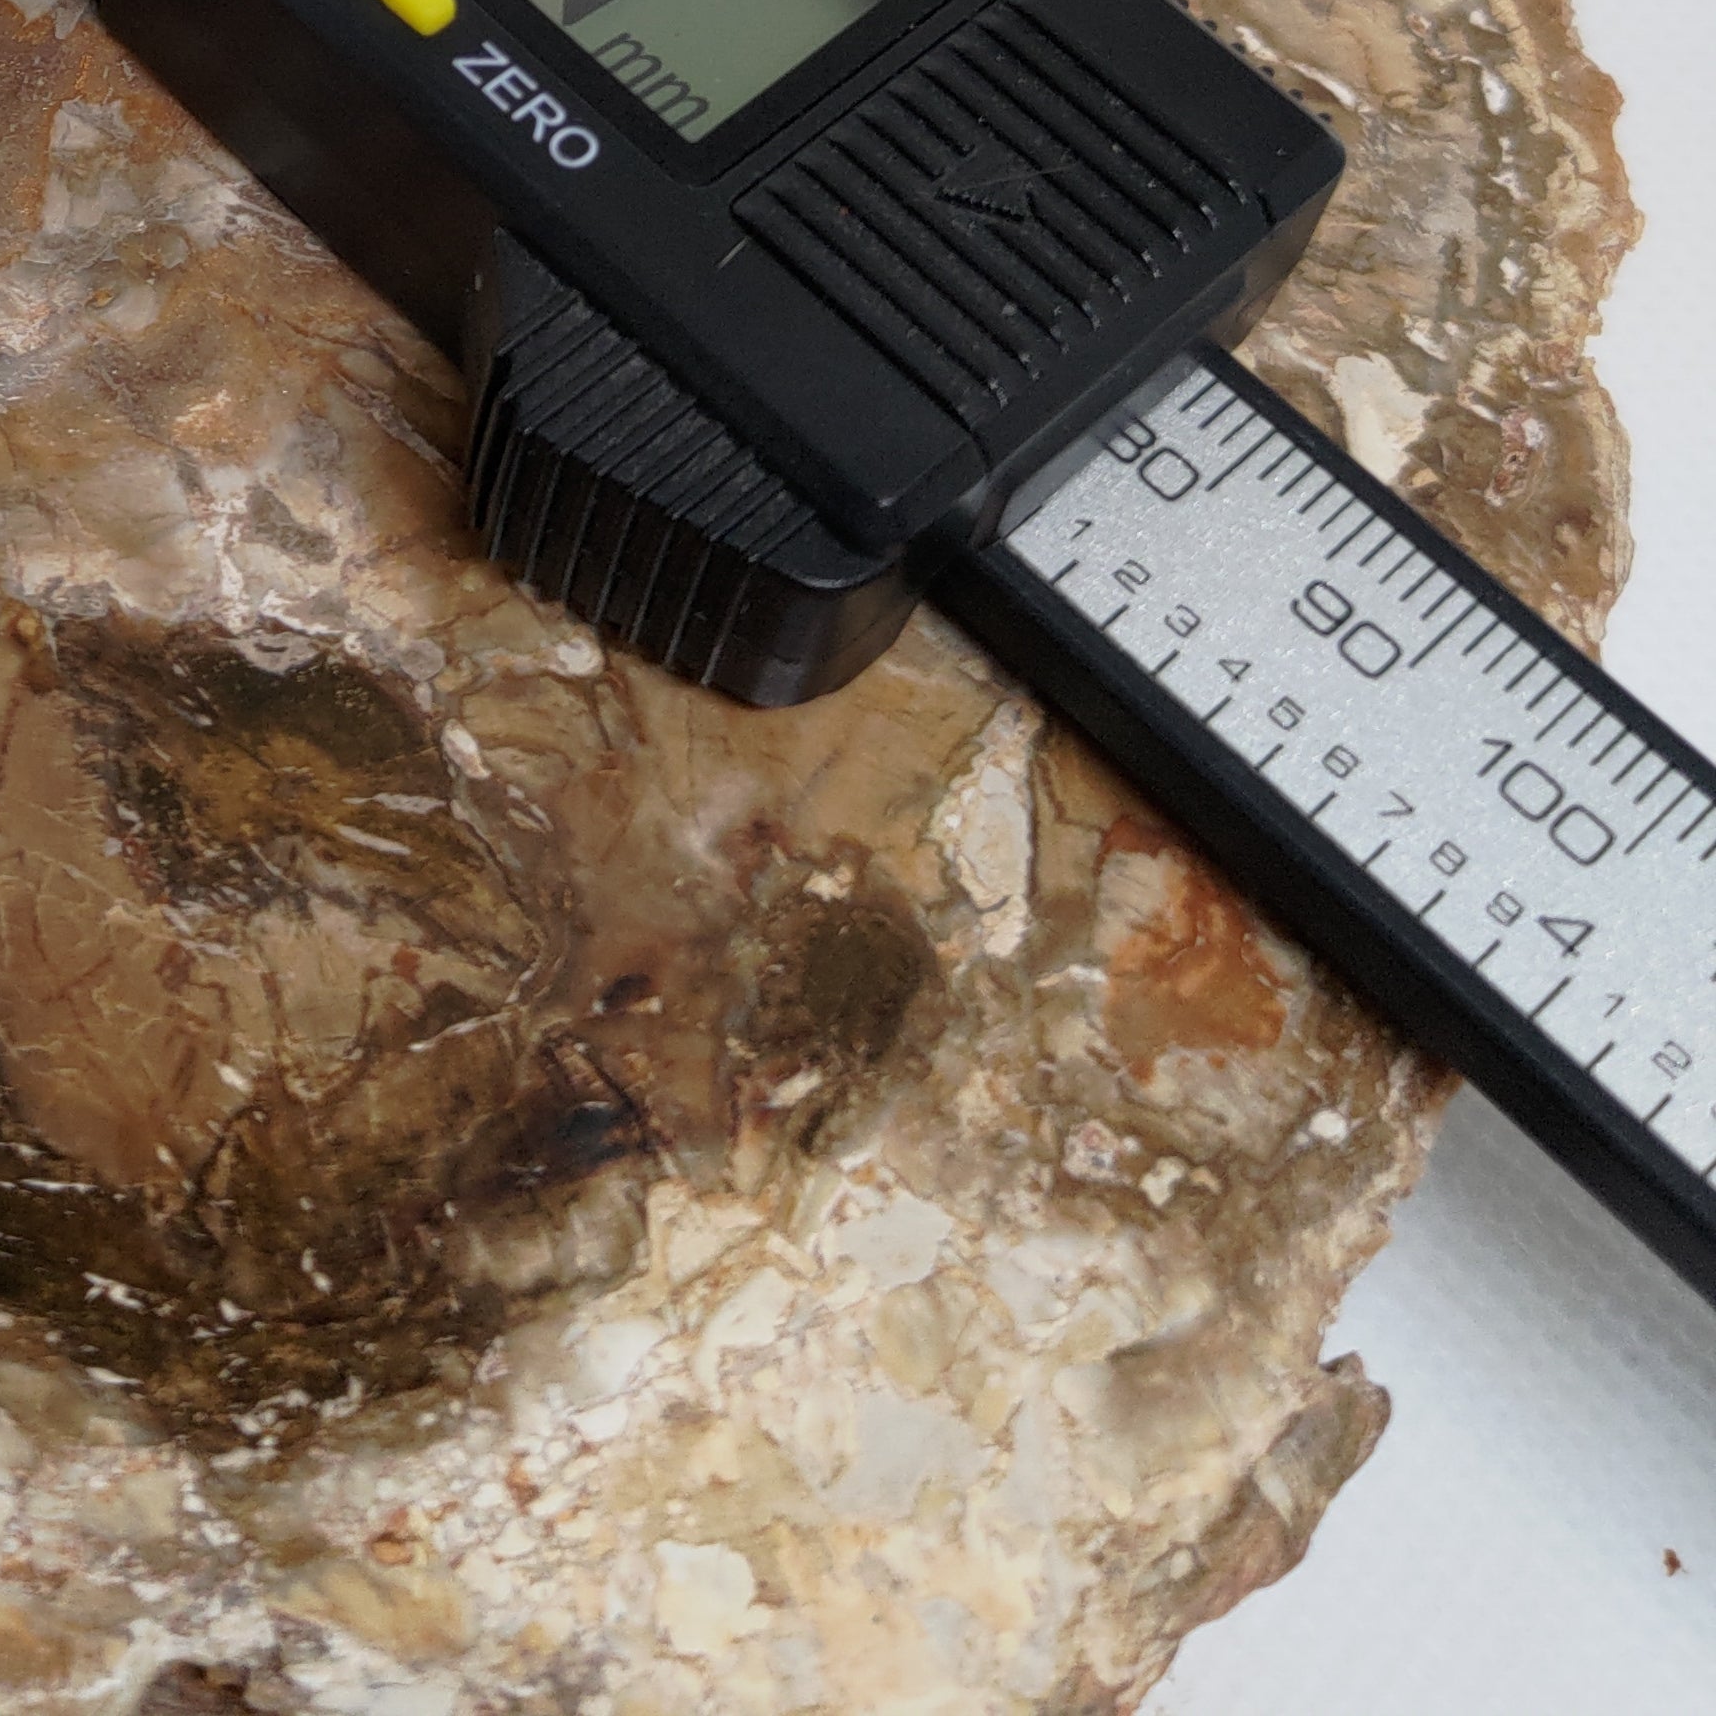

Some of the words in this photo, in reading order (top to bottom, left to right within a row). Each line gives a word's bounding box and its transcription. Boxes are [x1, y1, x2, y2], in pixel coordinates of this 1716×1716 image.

[452, 41, 602, 171] ZERO
[591, 32, 712, 131] mm
[1070, 517, 1094, 541] 1
[1111, 558, 1152, 595] 2
[1163, 603, 1202, 639] 3
[1217, 657, 1254, 683] 4
[1266, 695, 1307, 732] 5
[1321, 743, 1360, 779] 6
[1378, 791, 1416, 819] 7
[1429, 840, 1469, 877] 8
[1538, 915, 1596, 959] 4
[1604, 992, 1627, 1019] 1
[1651, 1039, 1693, 1081] 2
[1289, 579, 1403, 680] 90
[1477, 736, 1617, 867] 100
